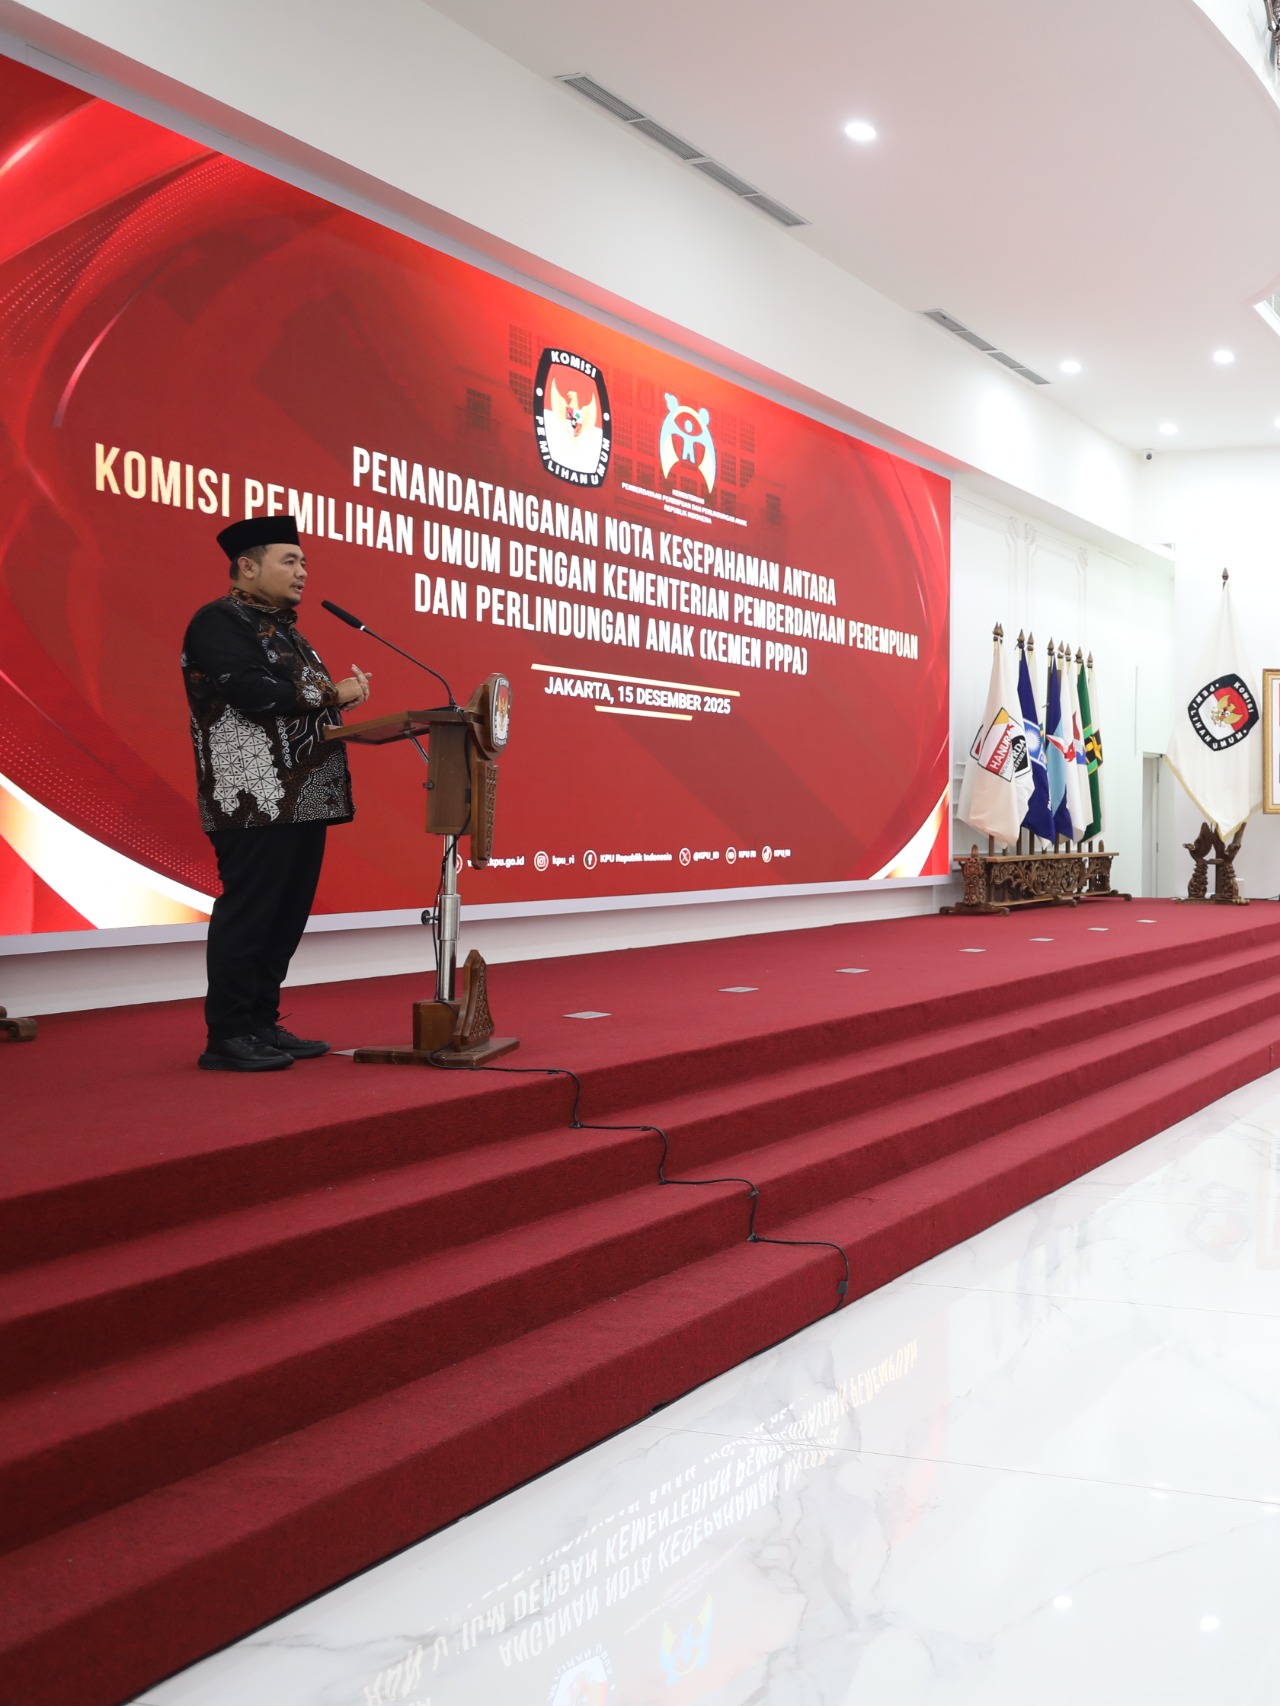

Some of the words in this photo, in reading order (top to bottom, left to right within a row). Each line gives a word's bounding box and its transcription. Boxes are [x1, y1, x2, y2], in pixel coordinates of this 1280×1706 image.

[551, 350, 597, 379] KOMISI
[535, 414, 588, 485] PEMILIHAN
[590, 437, 611, 485] UMUM
[353, 445, 599, 547] PENANDATANGANAN
[604, 515, 655, 562] NOTA
[659, 531, 780, 593] KESEPAHAMAN
[782, 565, 837, 607] ANTARA
[95, 442, 230, 518] KOMISI
[244, 477, 414, 556] PEMILIHAN
[423, 519, 501, 574] UMUM
[509, 540, 597, 594] DENGAN
[602, 562, 730, 622] KEMENTERIAN
[733, 592, 846, 646] PEMBERDAYAAN
[848, 619, 919, 661] PEREMPUAN
[414, 572, 467, 620] DAN
[476, 584, 641, 649] PERLINDUNGAN
[645, 617, 695, 658] ANAK
[699, 627, 762, 669] (KEMEN
[765, 640, 808, 676] PPPA)
[544, 676, 614, 705] JAKARTA,
[617, 685, 634, 704] 15
[636, 687, 702, 712] DESEMBER
[703, 695, 732, 715] 2025
[1190, 684, 1216, 743] PEMILIHAN
[1233, 681, 1255, 713] KOMISI
[1212, 731, 1244, 750] UMUM
[600, 854, 615, 864] KPU
